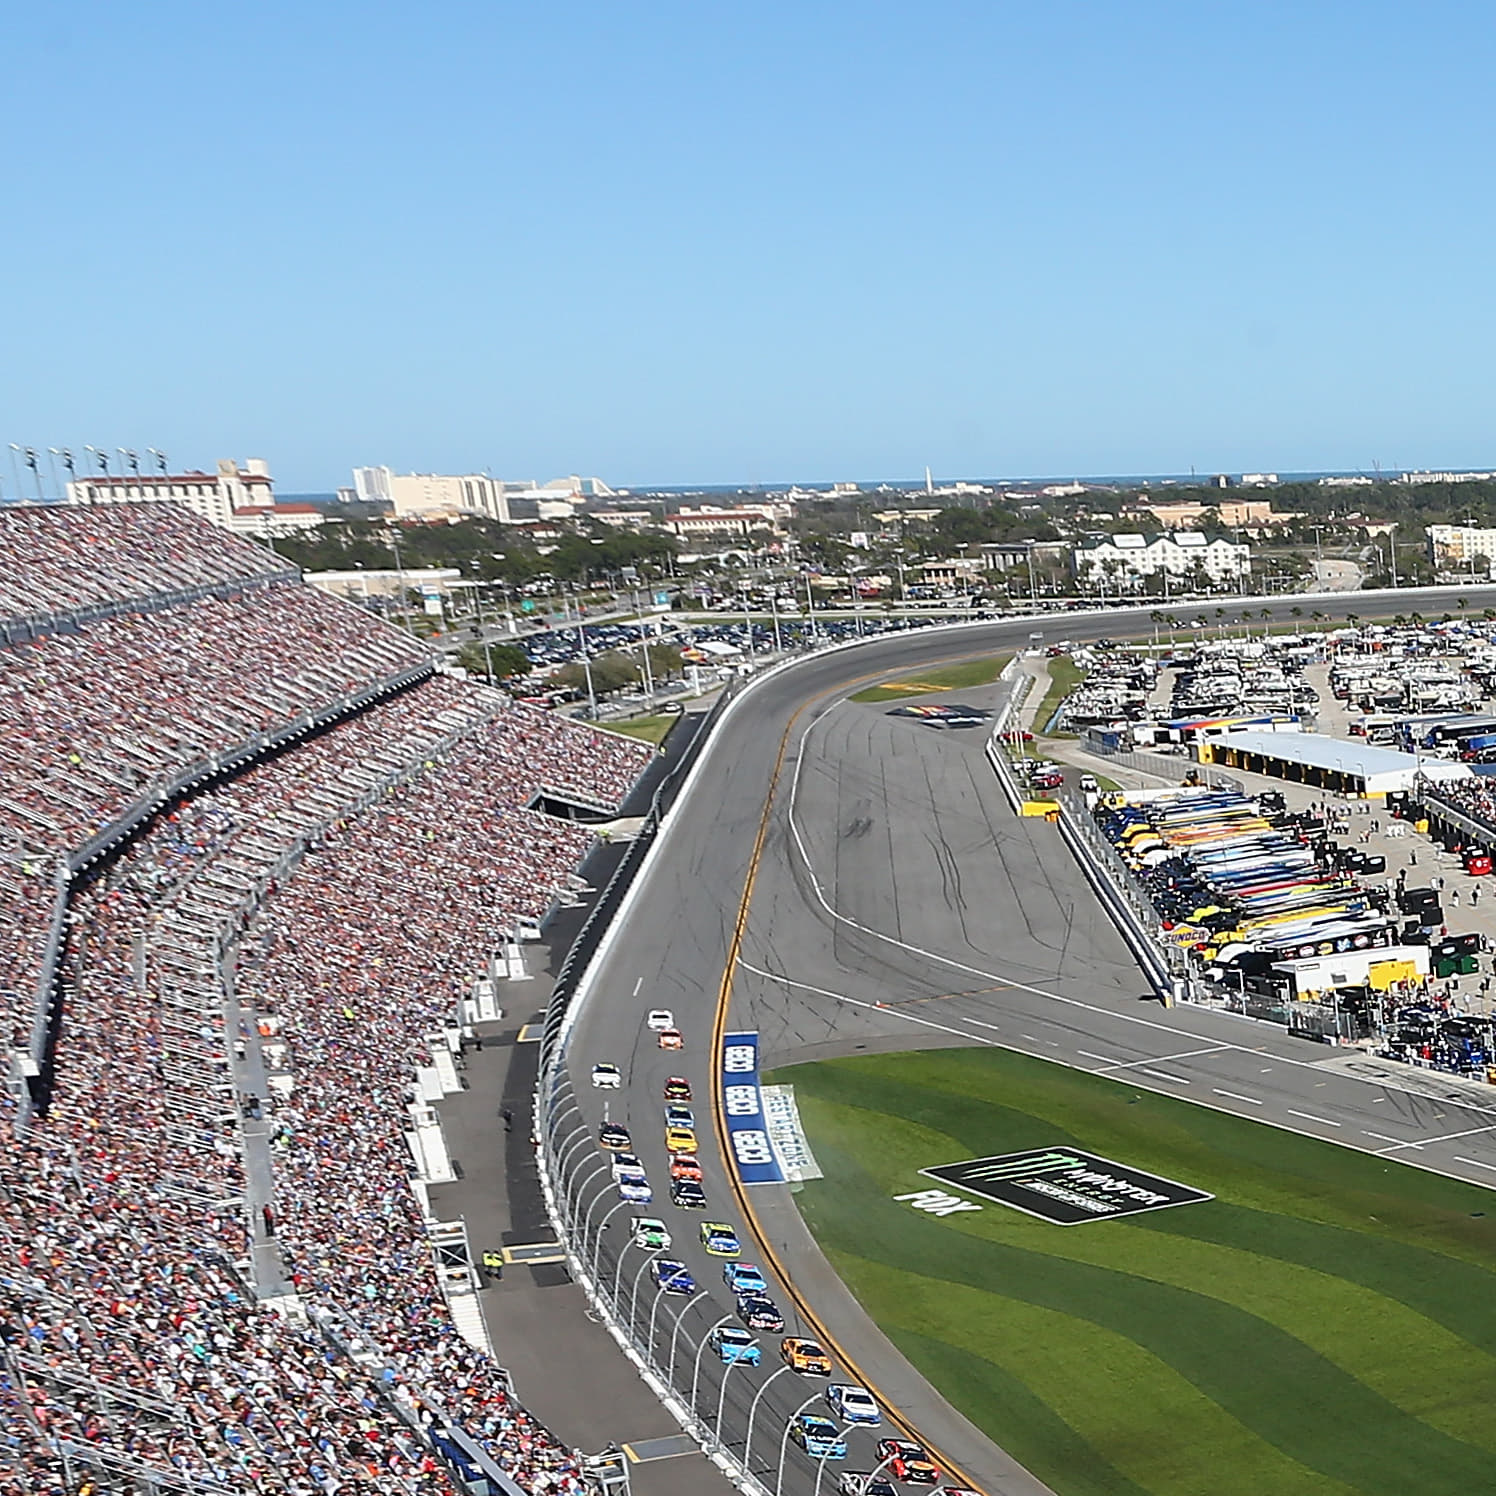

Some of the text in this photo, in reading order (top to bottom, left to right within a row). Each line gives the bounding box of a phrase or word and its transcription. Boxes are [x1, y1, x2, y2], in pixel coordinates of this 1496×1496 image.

[1163, 931, 1209, 945] SUNOCO
[777, 1138, 809, 1167] ZONE
[1063, 1168, 1170, 1205] MONSTER
[893, 1188, 984, 1217] FOX
